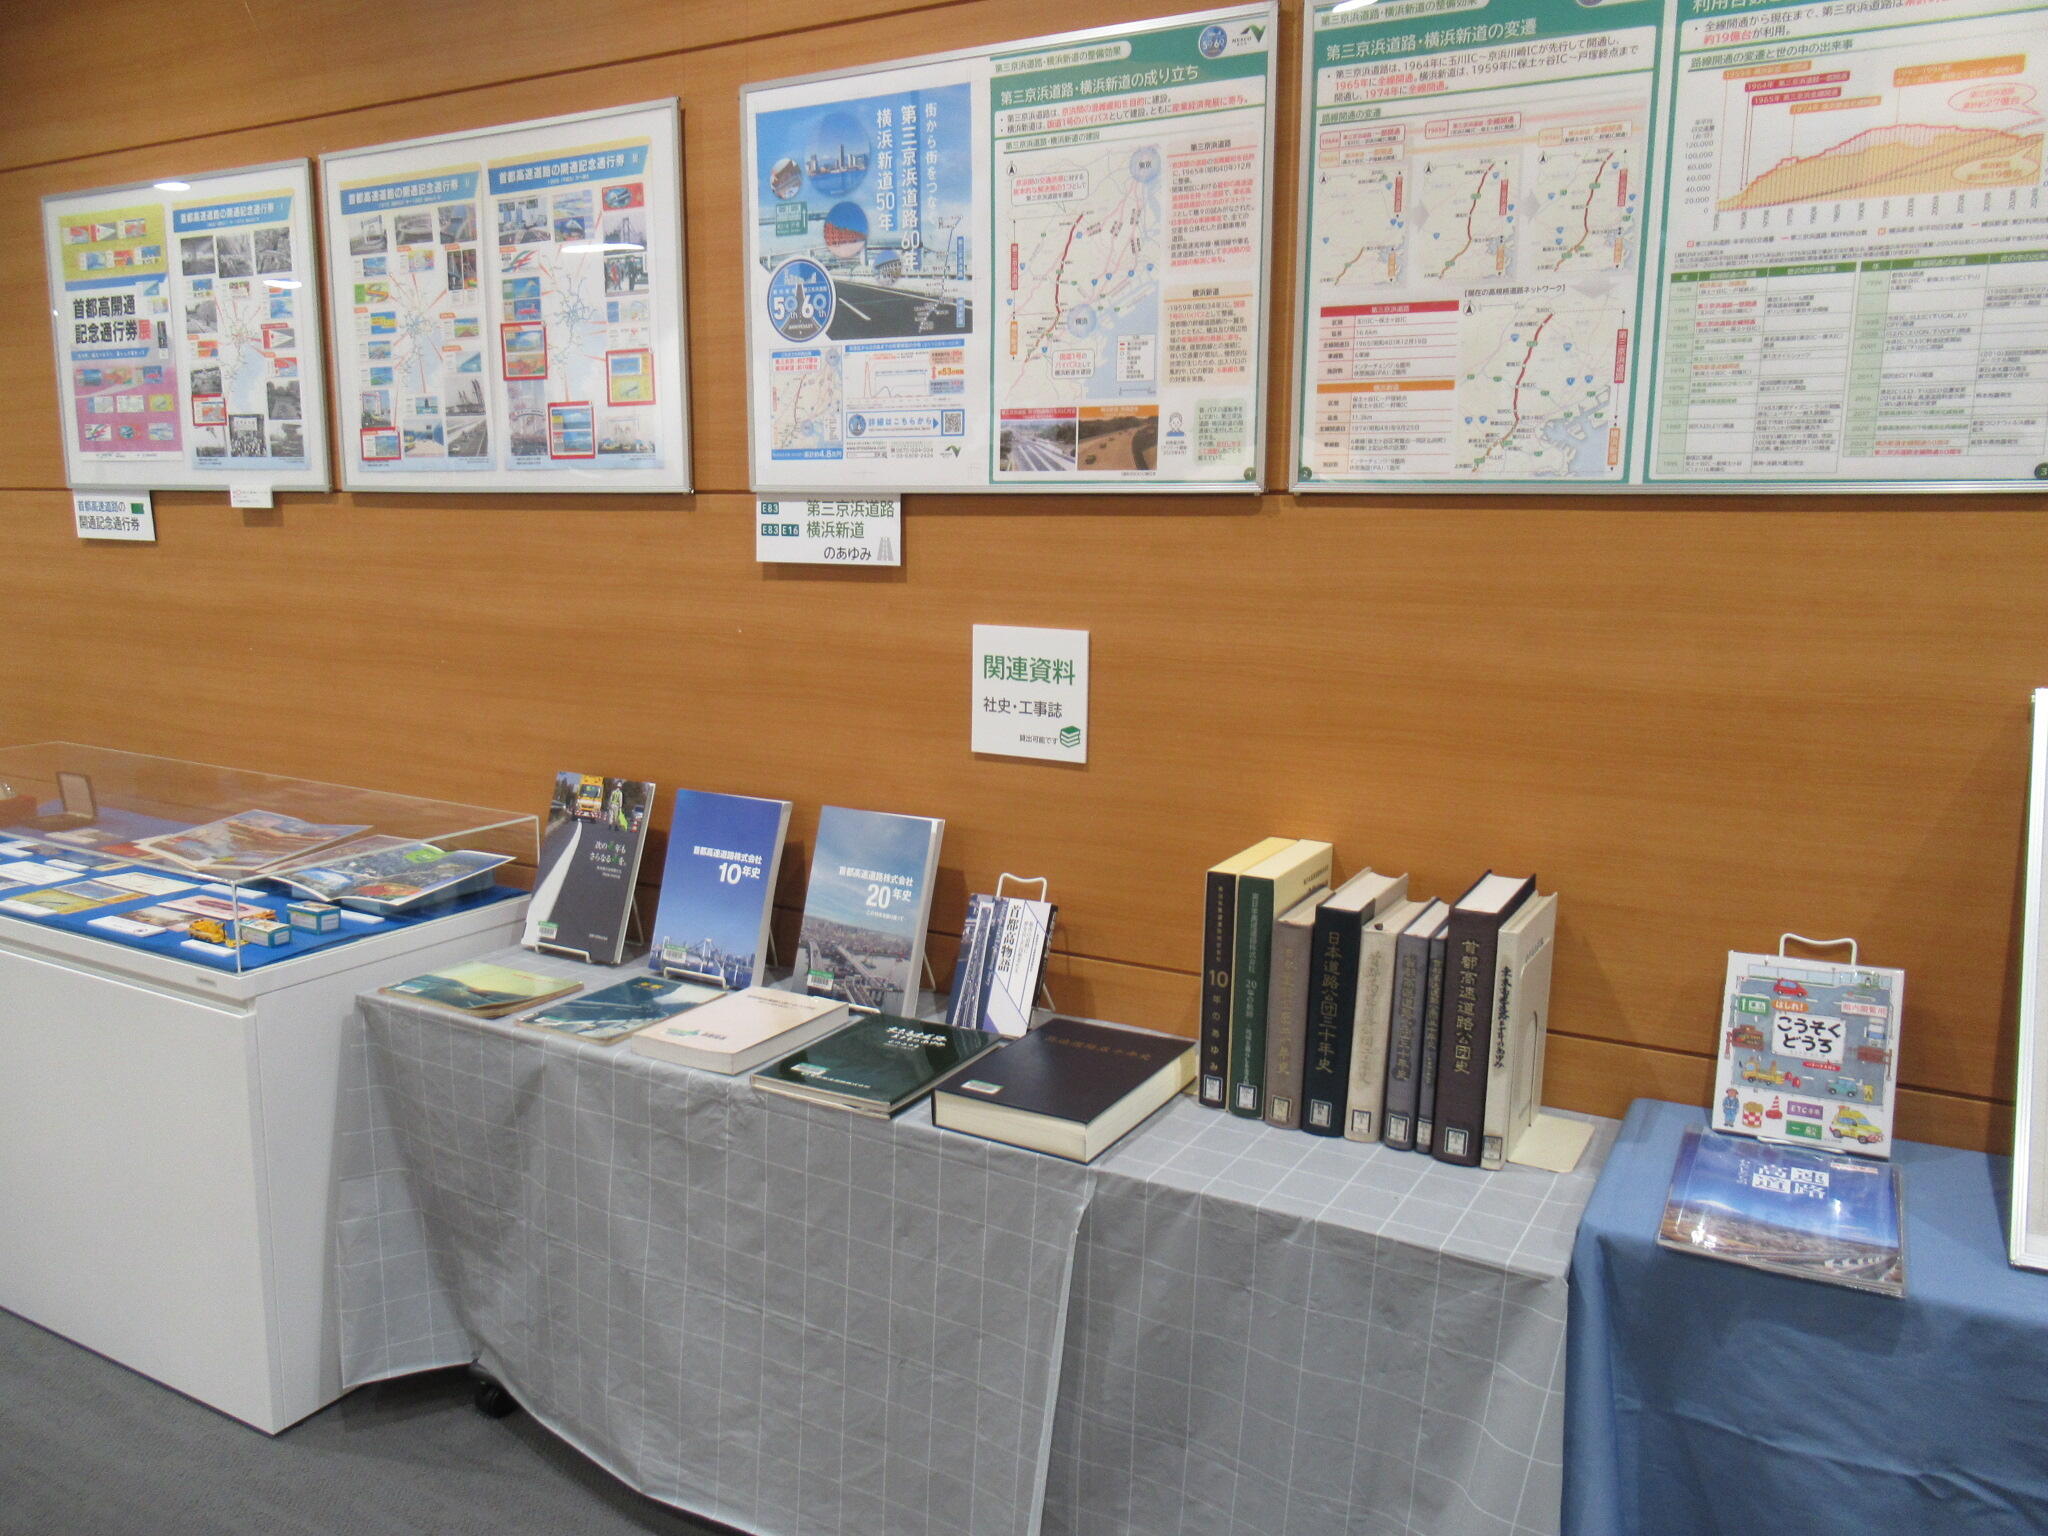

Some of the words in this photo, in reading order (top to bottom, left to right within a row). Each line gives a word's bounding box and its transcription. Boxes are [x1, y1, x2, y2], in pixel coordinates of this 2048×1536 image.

[1327, 17, 1537, 61] 第三京浜道路・横浜新道の変遷
[1704, 27, 1790, 45] 約19億台が利用。
[995, 46, 1121, 73] 第三京浜道路・横浜新道の整備効果
[1690, 38, 1853, 68] 路線開通の変遷と世の中の出来事
[1001, 64, 1199, 106] 第三京浜道路・横浜新道の成り立ち
[500, 151, 624, 185] 首都高速道路の開通記念通行券
[876, 109, 895, 231] 横浜新道50年
[901, 105, 921, 270] 第三京浜道路60年
[1192, 288, 1220, 297] 横浜新道
[73, 295, 135, 320] 首都高開通
[75, 320, 151, 344] 記念通行券展
[78, 500, 126, 513] 首都高速道路の
[762, 503, 779, 513] E83
[807, 500, 895, 518] 第三京浜道路
[79, 515, 140, 532] 開通記念通行券
[762, 525, 779, 535] E83
[782, 525, 799, 535] E16
[807, 521, 865, 538] 横浜新道
[824, 546, 872, 560] のあゆみ
[983, 655, 1076, 685] 関連資料
[983, 696, 1063, 718] 社史・工事誌
[1019, 734, 1058, 744] 貸出可能です
[693, 845, 763, 864] 首都高速道路株式会社
[718, 862, 761, 885] 10年史
[839, 866, 914, 887] 首都高速道路株式会社
[865, 883, 912, 909] 20年史
[998, 904, 1022, 973] 首都高物語
[1315, 931, 1343, 1075] 日本道路公団三十年史
[1454, 940, 1480, 1075] 首都高速道路公団史
[1775, 1001, 1804, 1012] はしれ!
[1777, 1016, 1841, 1038] こうそく
[1783, 1033, 1833, 1054] どうろ
